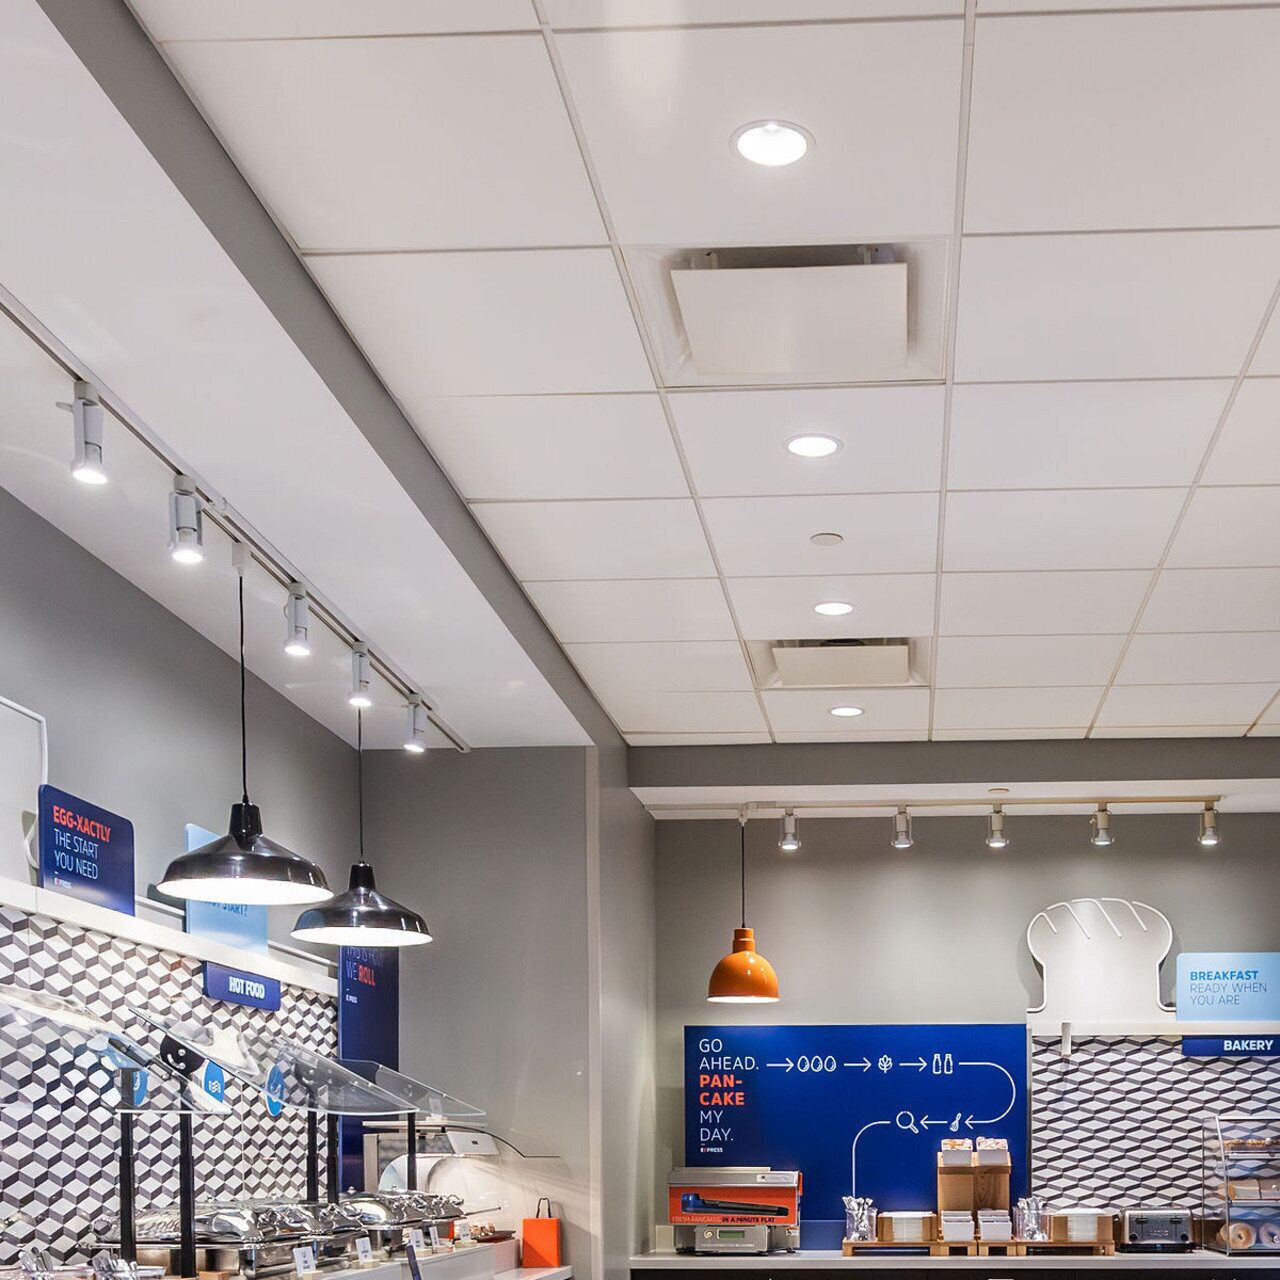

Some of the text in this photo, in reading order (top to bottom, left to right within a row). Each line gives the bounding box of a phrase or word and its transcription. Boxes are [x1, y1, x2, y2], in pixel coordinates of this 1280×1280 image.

[53, 805, 111, 842] EGG-XACTLY
[53, 828, 98, 859] THE START
[54, 850, 98, 880] YOU NEED
[1190, 970, 1259, 981] BREAKFAST
[228, 976, 265, 999] HOT FOOD
[1189, 982, 1268, 993] READY WHEN
[1190, 994, 1240, 1005] YOU ARE
[699, 1038, 723, 1053] GO
[1223, 1039, 1274, 1051] BAKERY
[699, 1056, 759, 1070] AHEAD.
[699, 1073, 743, 1088] PAN-
[699, 1091, 745, 1106] CAKE
[700, 1110, 723, 1124] MY
[700, 1127, 734, 1141] DAY.
